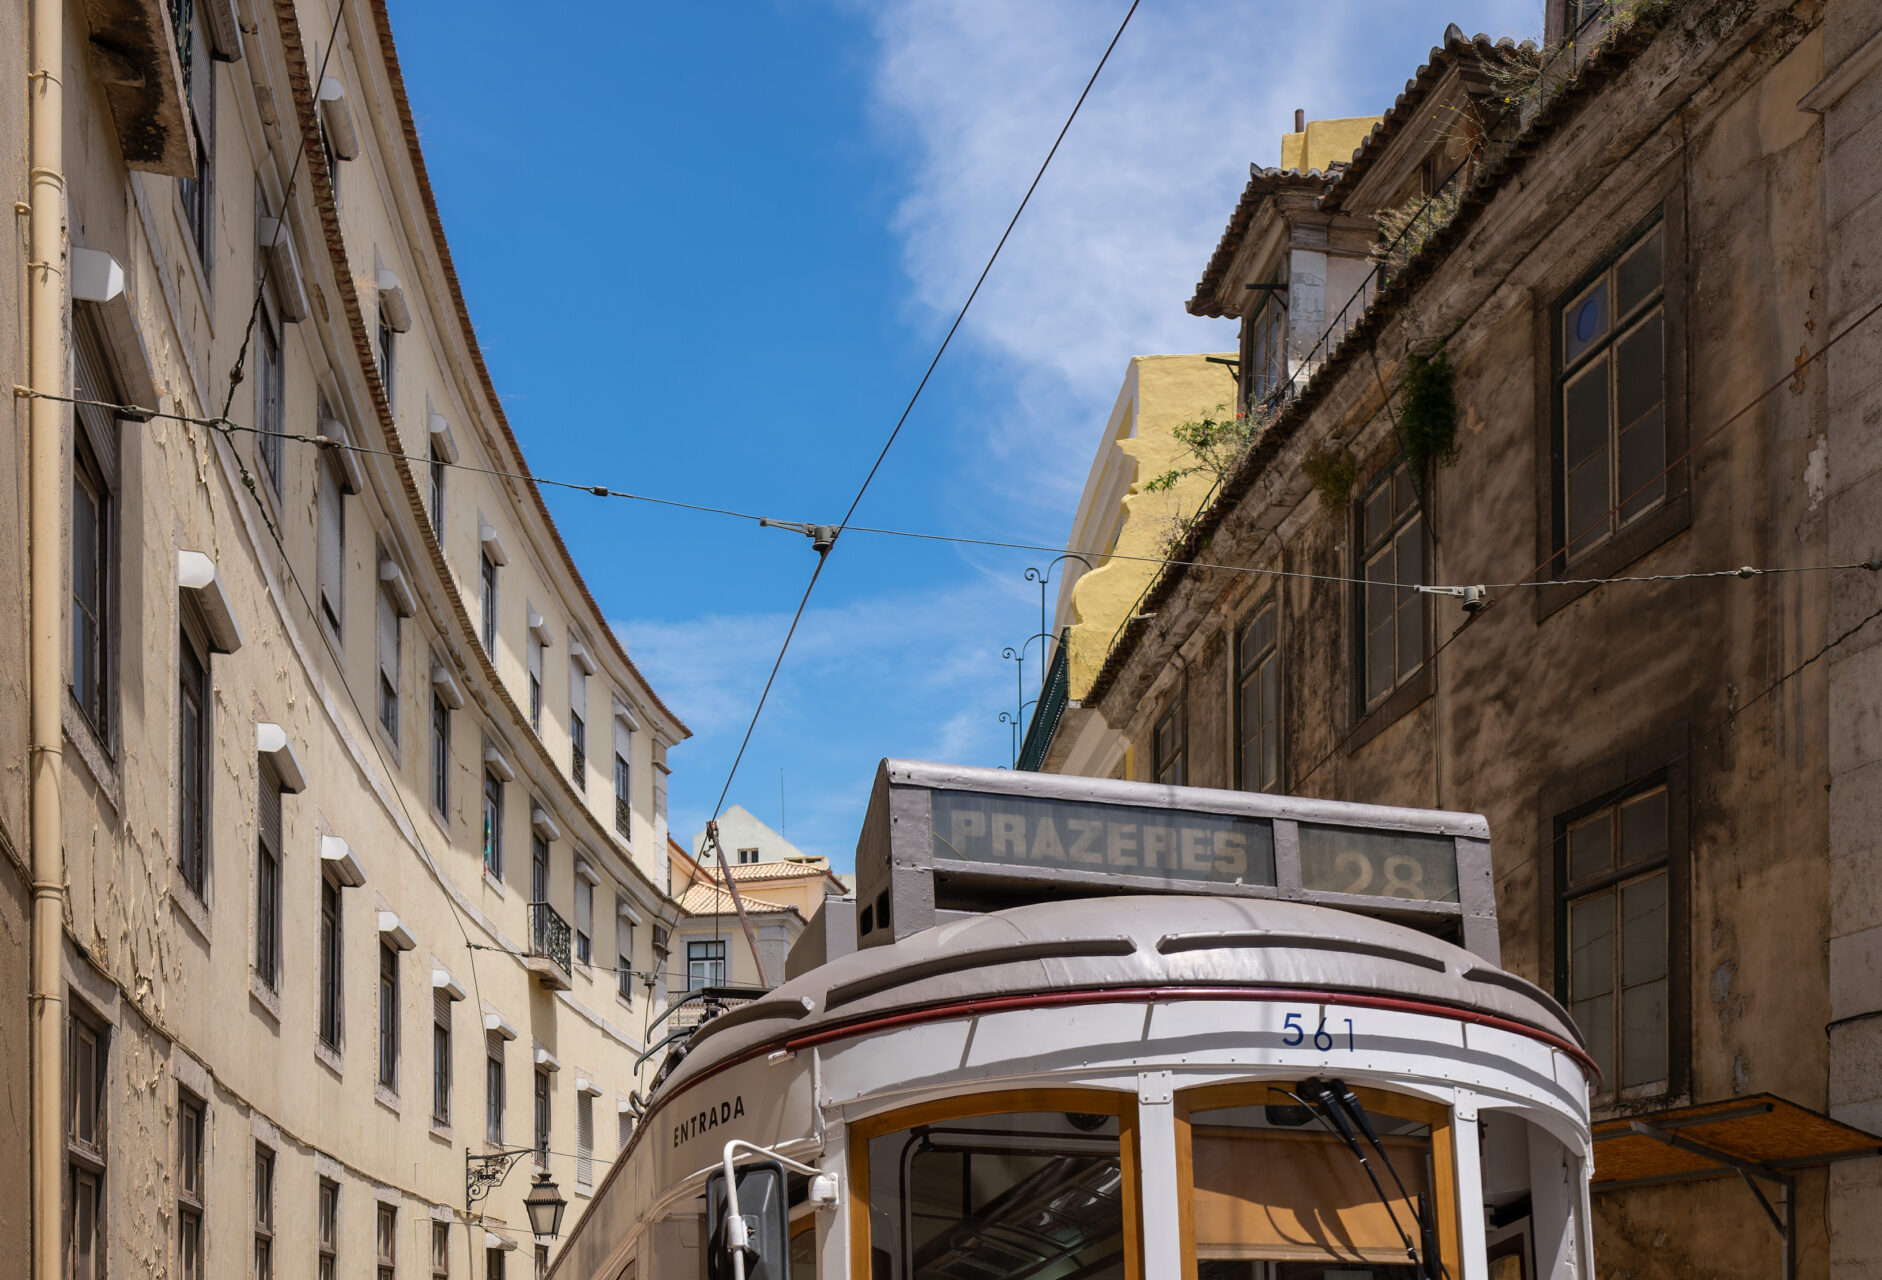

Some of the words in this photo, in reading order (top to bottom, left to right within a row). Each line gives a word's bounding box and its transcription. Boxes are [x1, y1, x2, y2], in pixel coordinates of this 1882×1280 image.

[950, 810, 1248, 875] PRAZERES
[1334, 851, 1424, 901] 28
[1282, 1012, 1354, 1052] 561
[673, 1095, 745, 1148] ENTRADA
